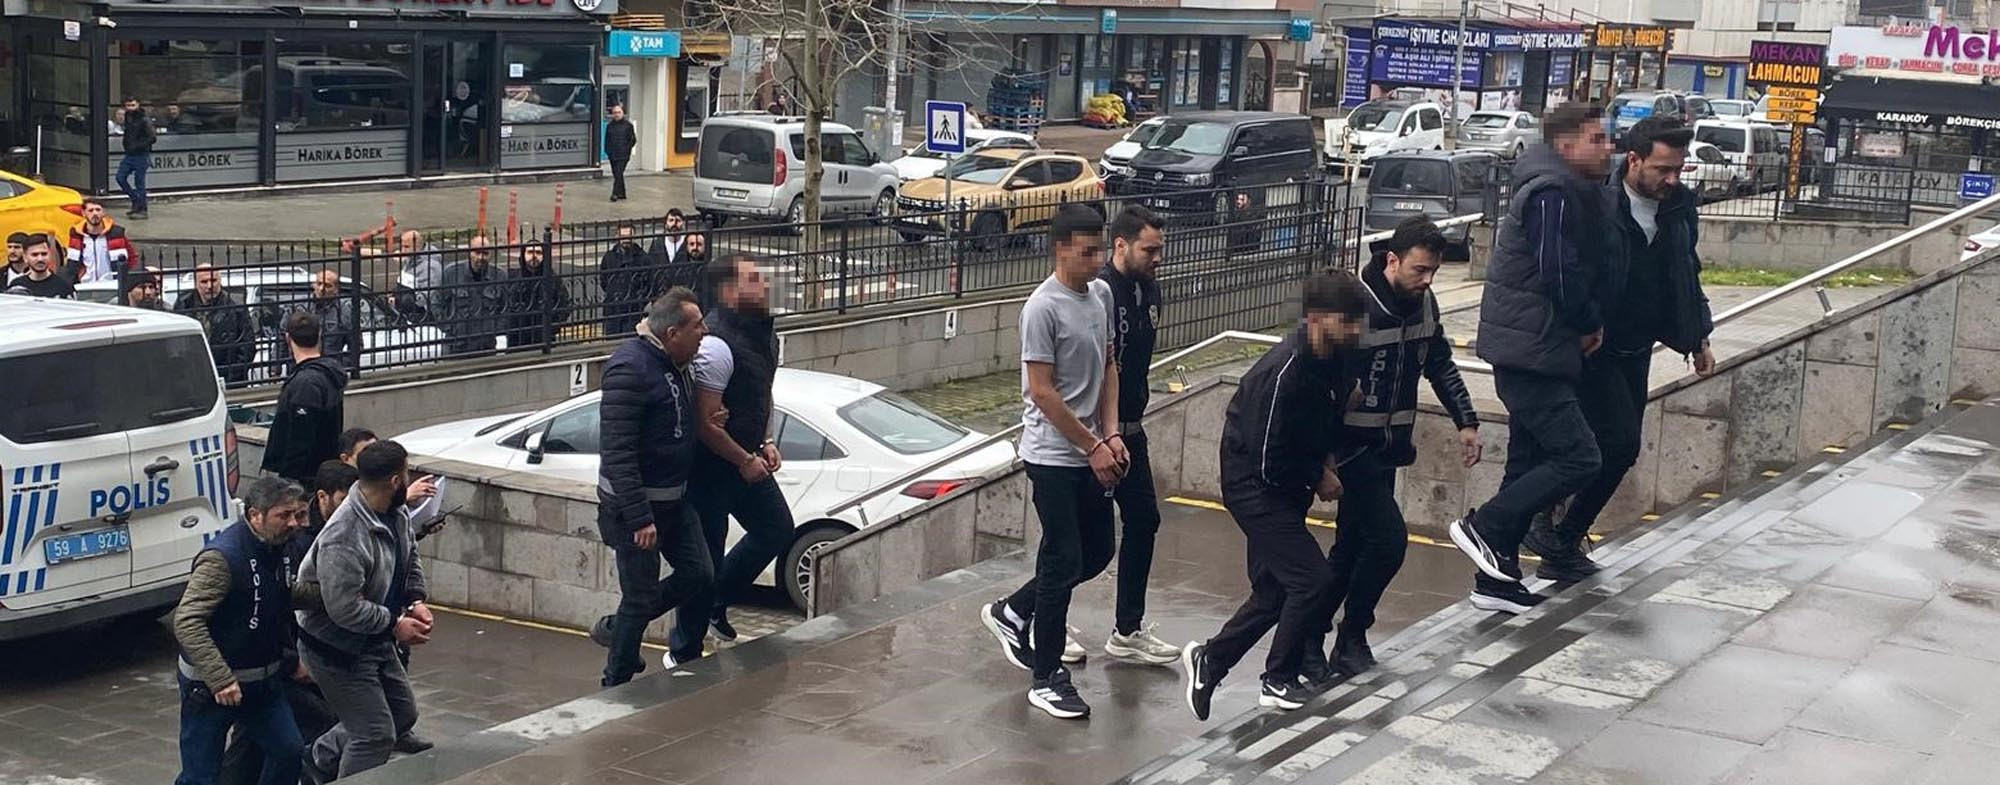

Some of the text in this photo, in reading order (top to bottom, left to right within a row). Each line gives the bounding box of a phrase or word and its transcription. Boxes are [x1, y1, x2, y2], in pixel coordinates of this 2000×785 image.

[643, 37, 663, 48] TAM
[1751, 44, 1820, 62] MEKAN
[1748, 62, 1820, 84] LAHMACUN
[1876, 111, 1929, 123] KARAKÖY
[547, 138, 578, 151] BÖREK
[187, 152, 231, 167] BÖREK
[298, 146, 382, 161] HARİKA BÖREK
[948, 312, 954, 329] 4
[575, 364, 582, 385] 2
[90, 476, 171, 517] POLİS
[54, 531, 129, 557] 59 A 9276
